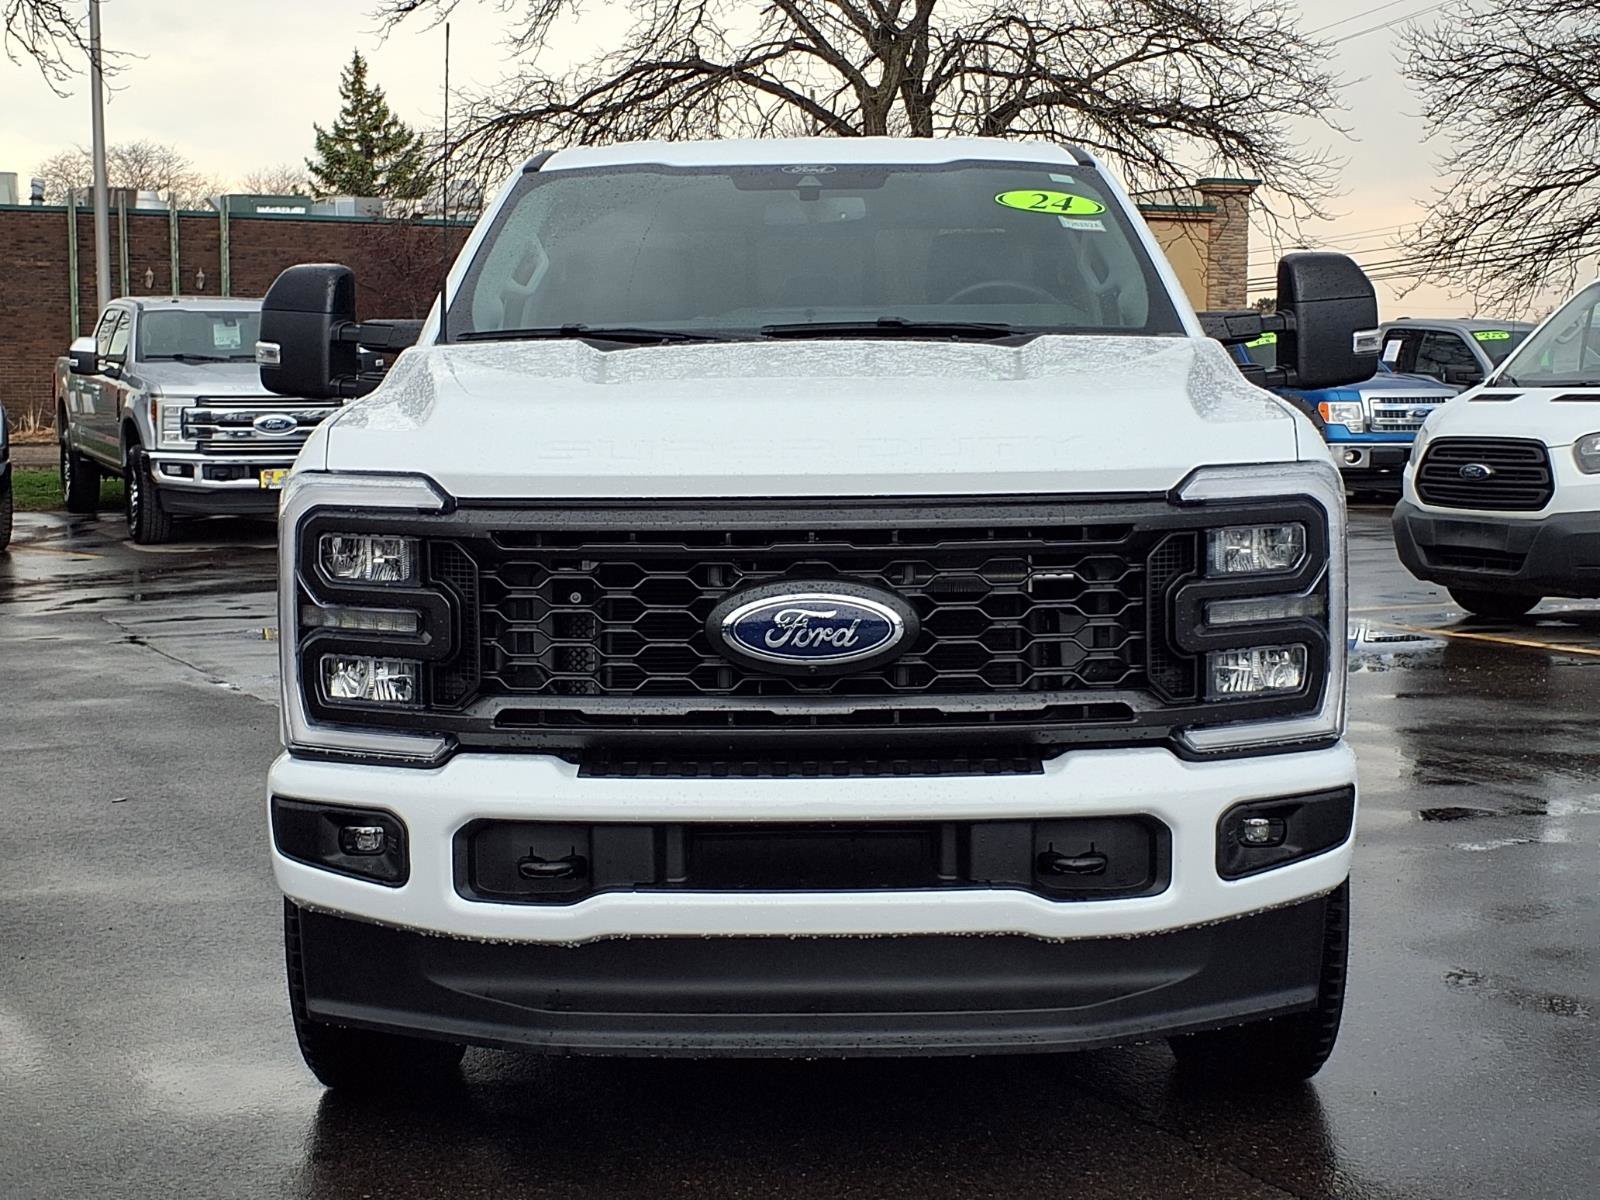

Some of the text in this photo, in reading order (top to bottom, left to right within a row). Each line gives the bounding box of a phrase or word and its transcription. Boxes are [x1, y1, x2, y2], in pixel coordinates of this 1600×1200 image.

[791, 165, 826, 174] Ford
[1028, 193, 1074, 211] 24
[265, 419, 286, 429] Ford
[537, 434, 1085, 460] SUPER DUTY
[764, 608, 860, 648] Ford
